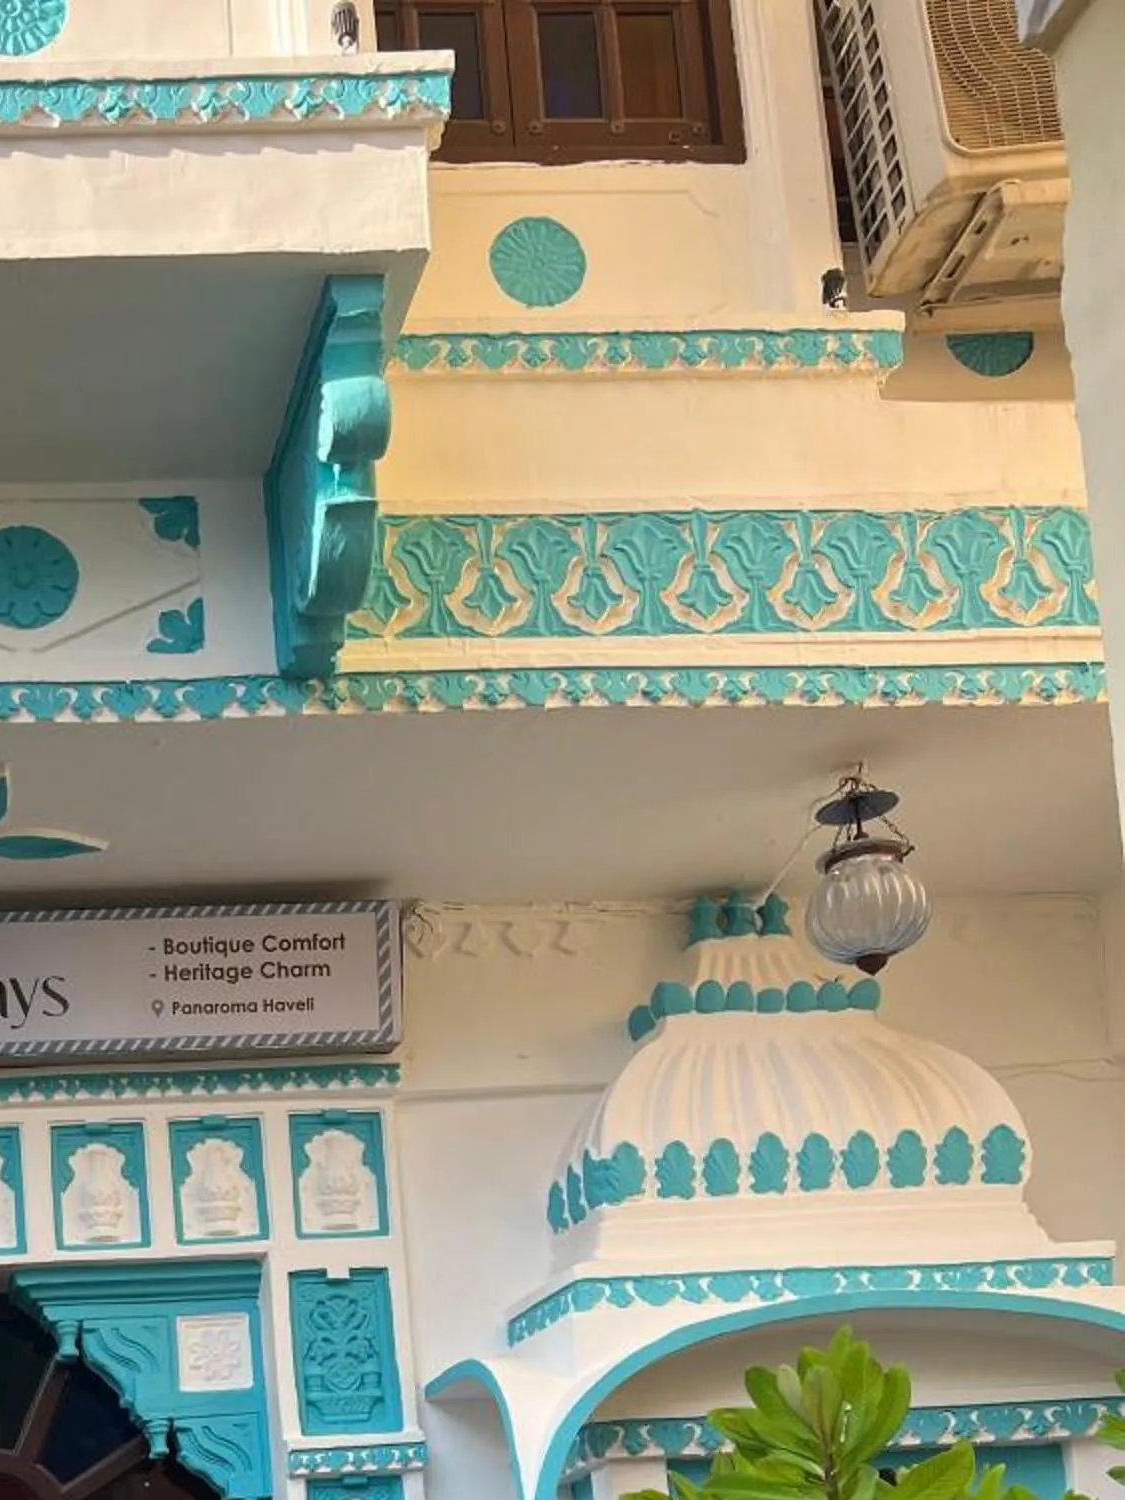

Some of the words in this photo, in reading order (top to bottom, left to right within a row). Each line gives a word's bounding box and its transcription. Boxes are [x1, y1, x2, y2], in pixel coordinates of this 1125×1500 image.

[163, 936, 255, 958] Boutique
[262, 934, 345, 953] Comfort
[164, 964, 253, 984] Heritage
[260, 962, 330, 979] Charm
[172, 1001, 258, 1015] Panaroma
[263, 998, 314, 1013] Haveli
